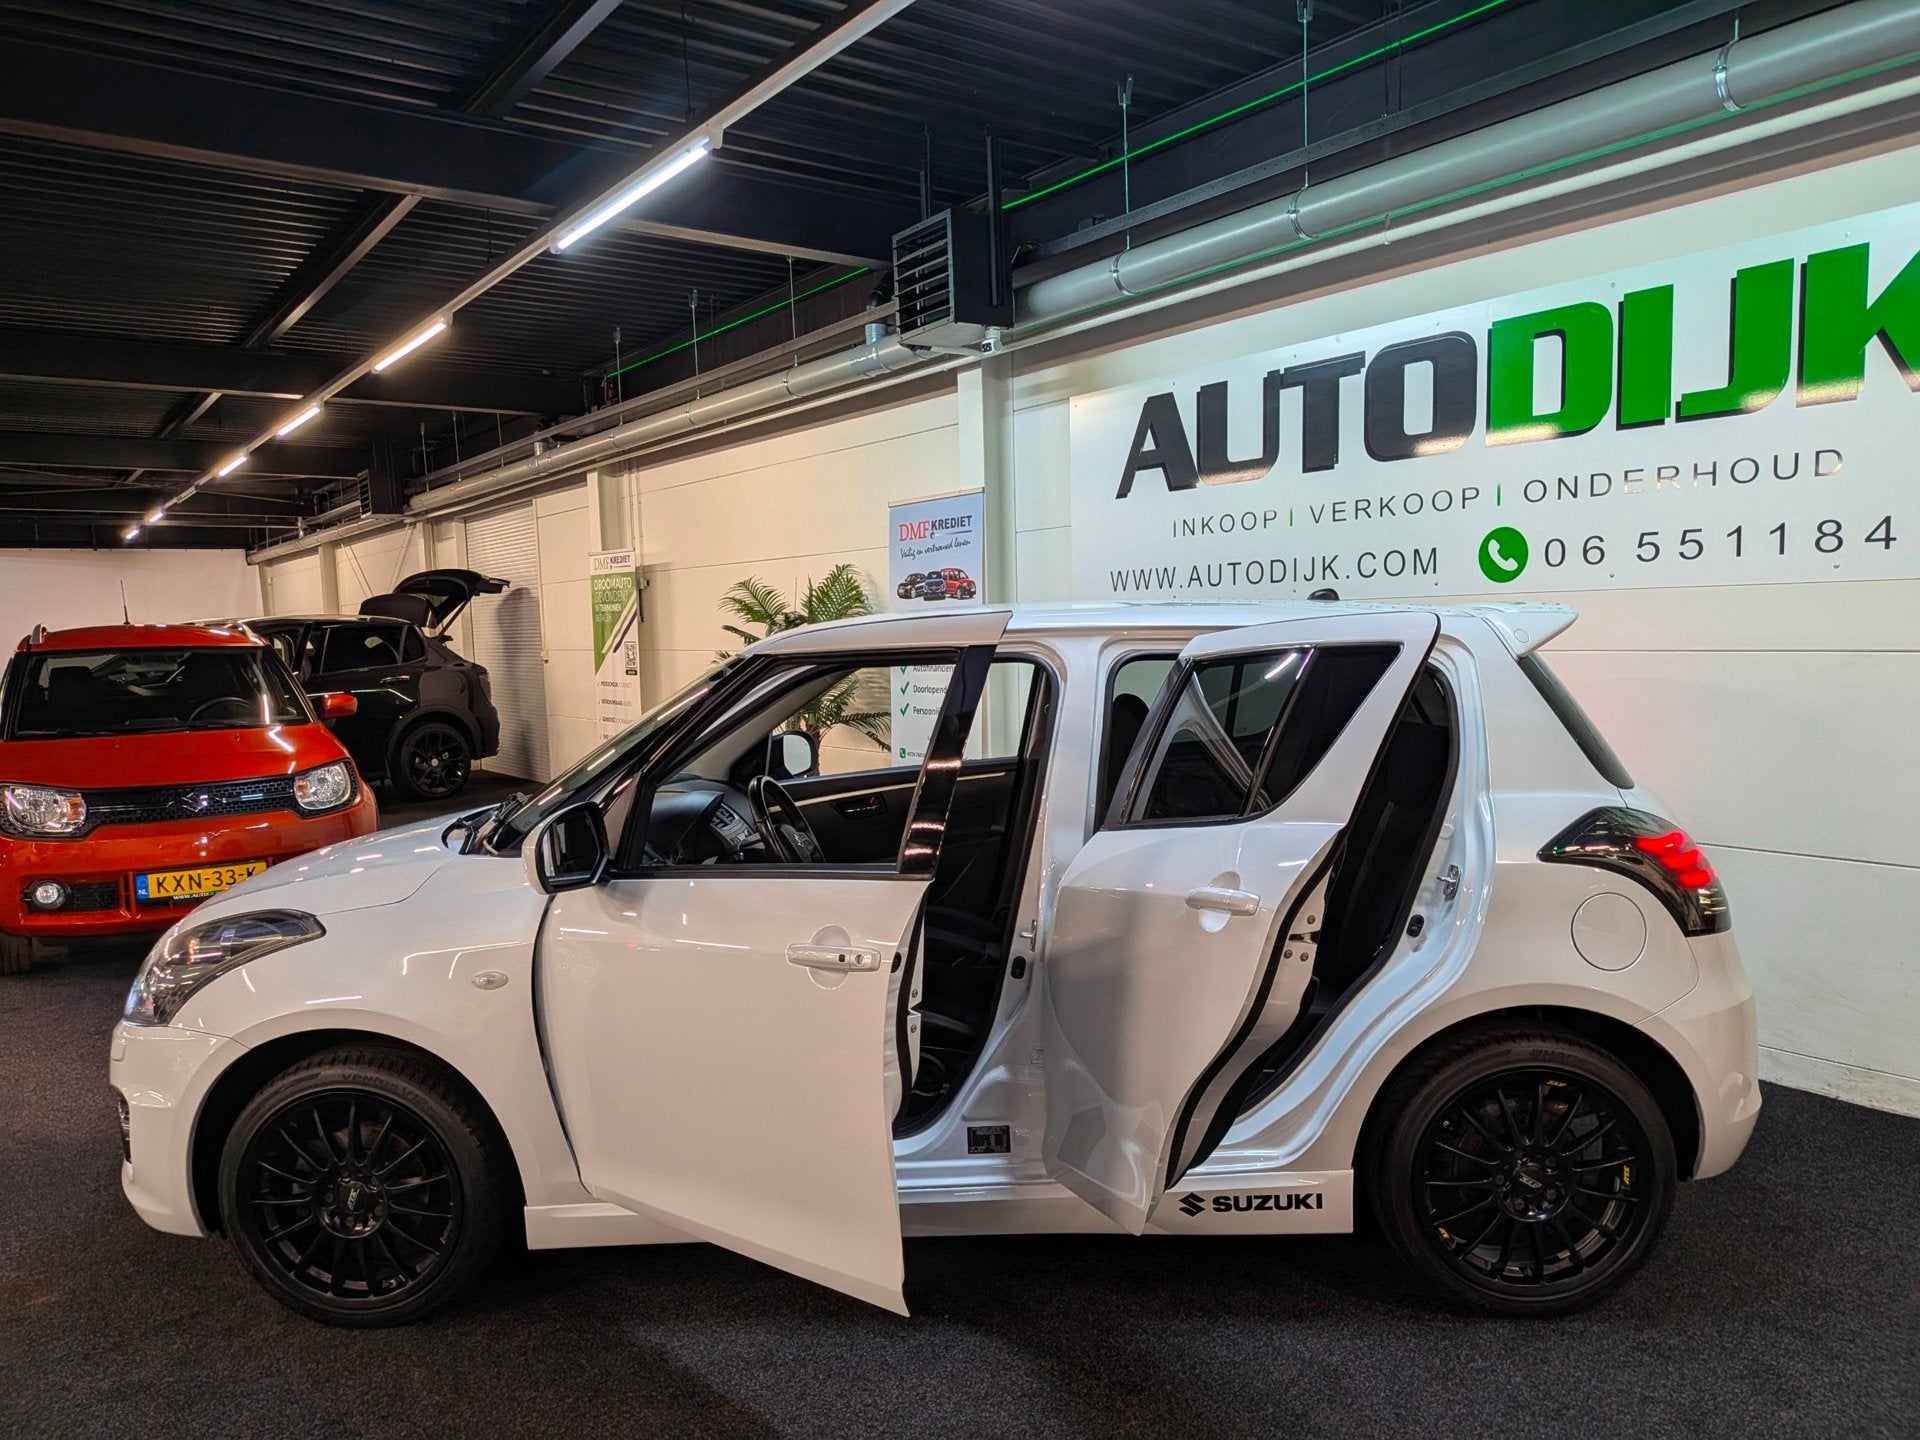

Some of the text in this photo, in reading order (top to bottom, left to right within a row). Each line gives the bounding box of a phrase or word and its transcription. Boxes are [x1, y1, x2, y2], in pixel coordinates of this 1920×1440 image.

[1115, 242, 1920, 499] AUTODIJK
[1172, 449, 1844, 538] INKOOP VERKOOP ONDERHOUD
[898, 515, 973, 542] DMF KREDIET
[1544, 515, 1898, 567] 06 551184
[610, 555, 631, 564] KREDIET
[1110, 547, 1438, 592] WWW.AUTODIJK.COM
[593, 577, 632, 590] DROOMAUTO
[155, 866, 256, 894] KXN-33-K
[1212, 1193, 1323, 1213] SUZUKI
